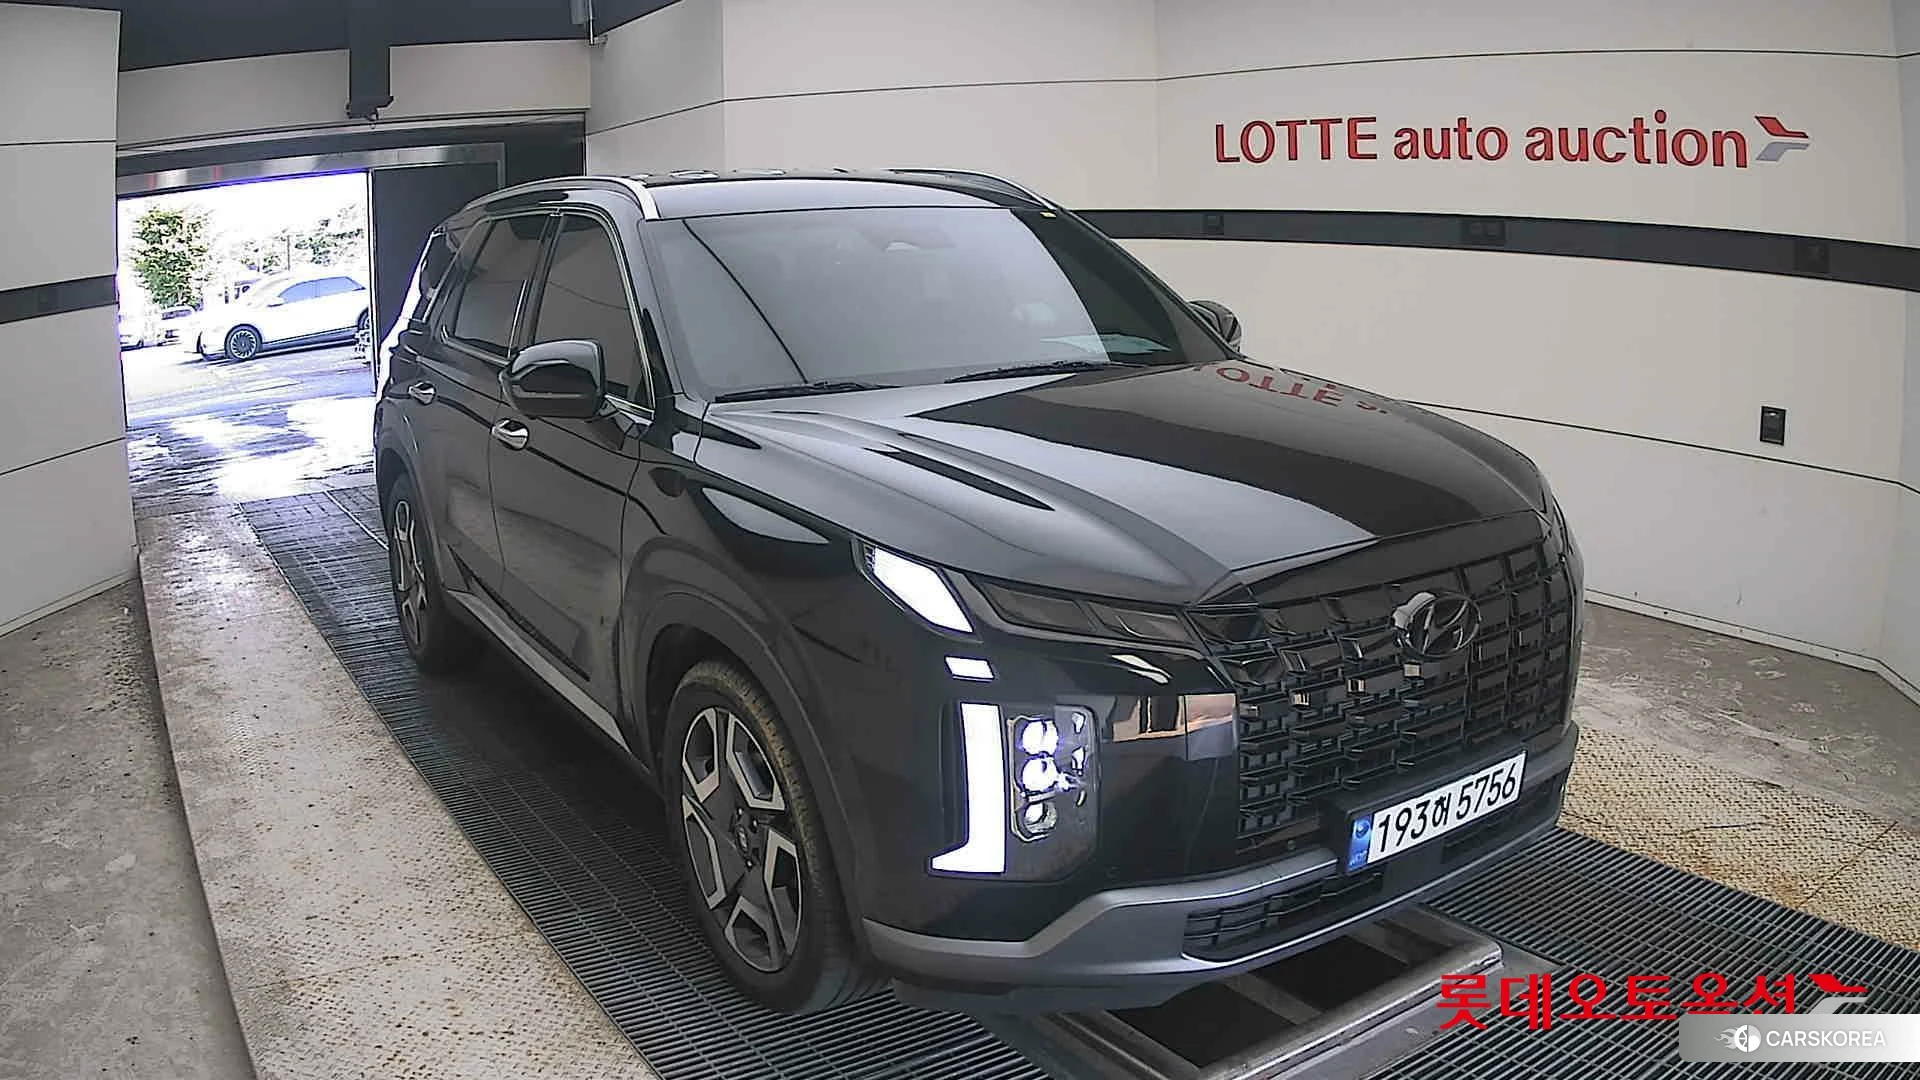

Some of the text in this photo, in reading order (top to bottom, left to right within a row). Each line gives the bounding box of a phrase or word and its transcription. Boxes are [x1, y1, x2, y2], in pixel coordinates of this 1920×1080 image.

[1215, 110, 1748, 168] LOTTE auto auction
